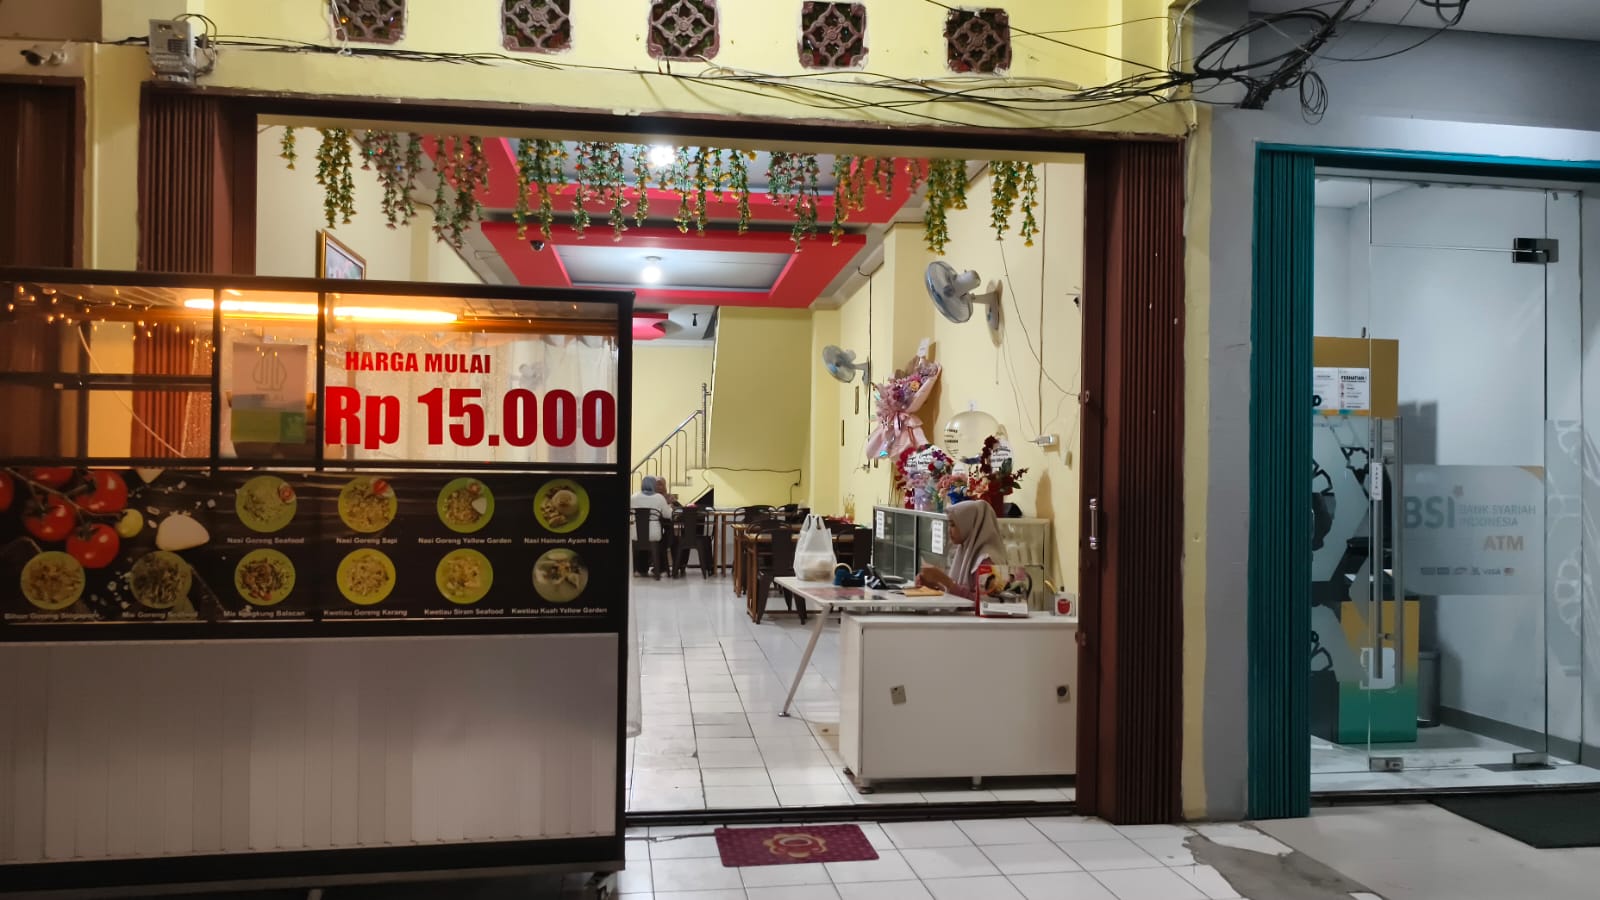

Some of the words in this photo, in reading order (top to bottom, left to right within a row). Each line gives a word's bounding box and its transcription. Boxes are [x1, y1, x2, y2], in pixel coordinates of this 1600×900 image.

[345, 351, 419, 372] HARGA
[424, 353, 491, 374] MULAI
[325, 386, 401, 450] Rp
[417, 387, 616, 448] 15.000
[1403, 496, 1456, 529] BSI
[1491, 504, 1537, 515] SYARIAH
[1459, 516, 1519, 527] INDONESIA
[245, 537, 273, 546] Goreng
[353, 537, 380, 546] Goreng
[381, 537, 398, 546] Sapi
[435, 537, 462, 546] Goreng
[567, 537, 587, 546] Ayam
[1483, 535, 1524, 551] ATM
[353, 609, 380, 617] Goreng
[582, 606, 608, 614] Garden
